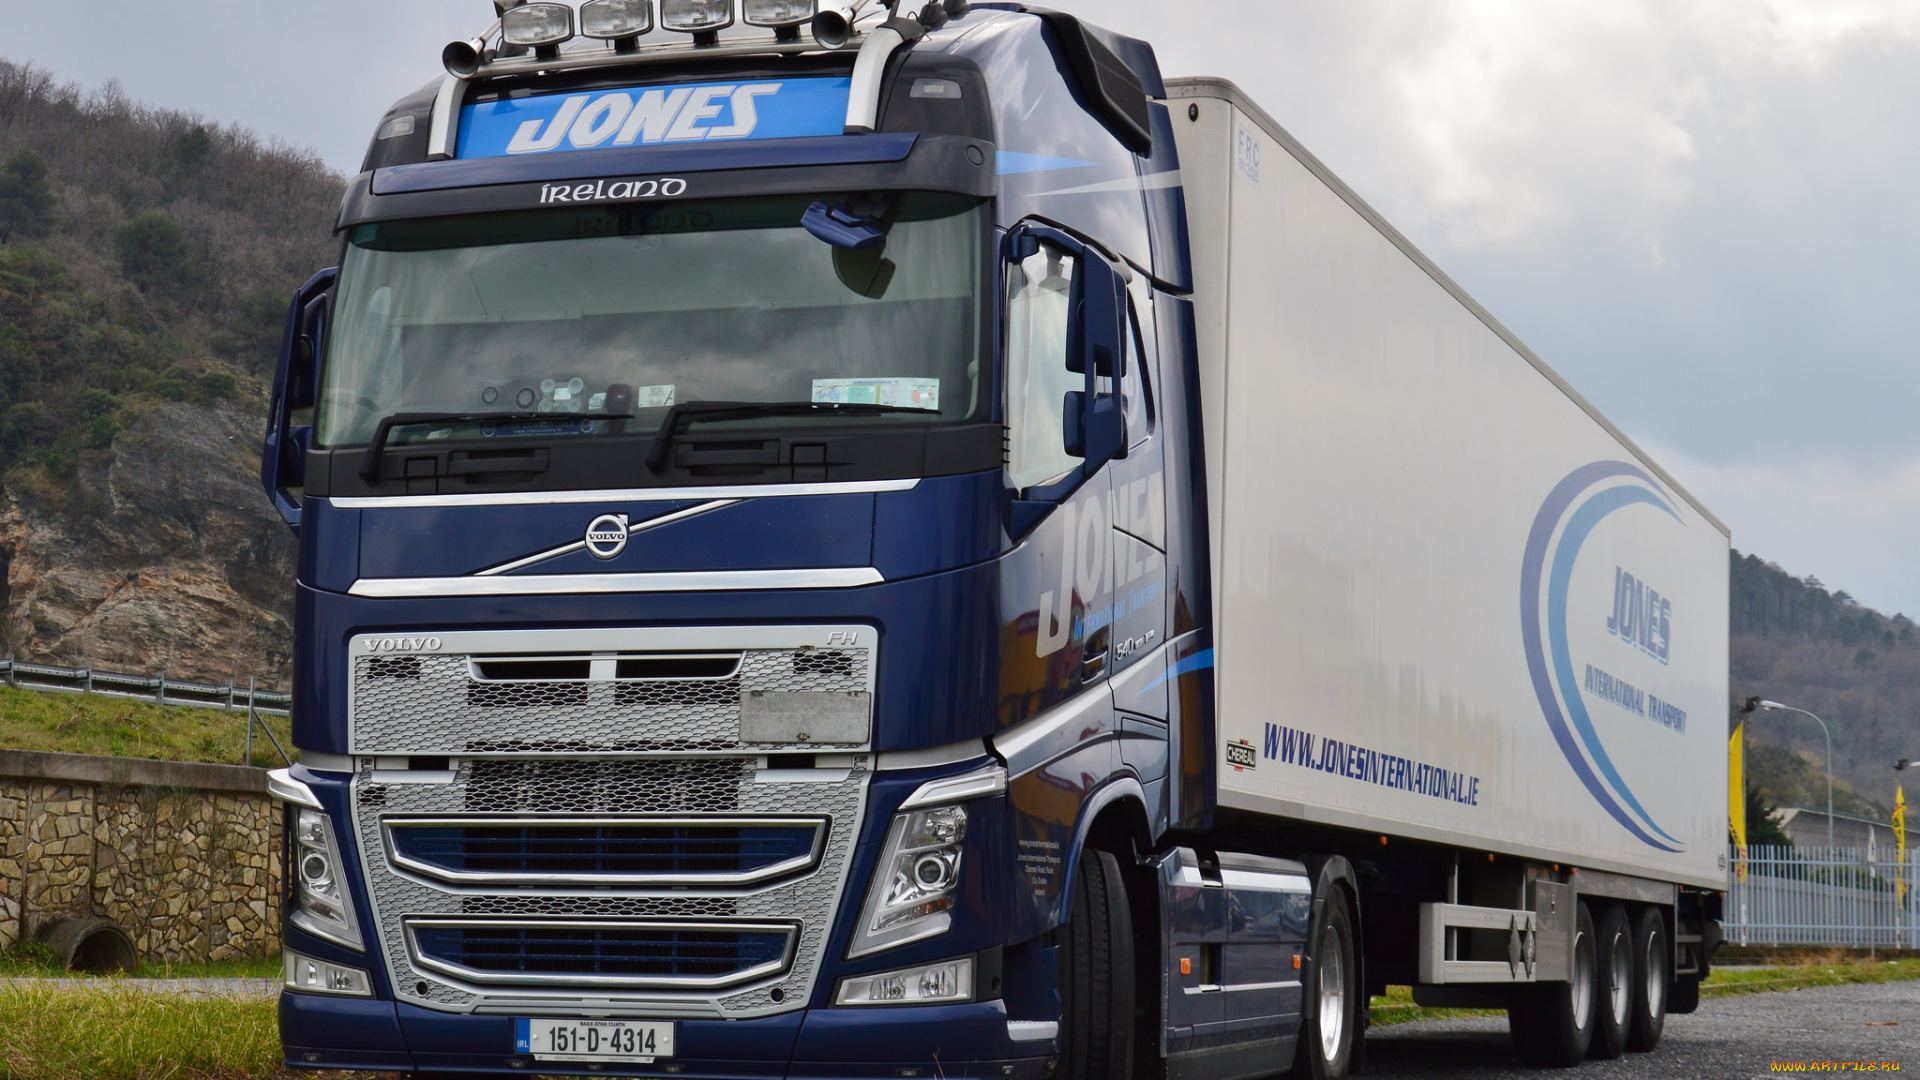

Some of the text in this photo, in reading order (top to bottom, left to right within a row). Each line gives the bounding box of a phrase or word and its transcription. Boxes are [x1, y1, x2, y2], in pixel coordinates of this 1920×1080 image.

[506, 83, 783, 154] JONES
[1036, 471, 1164, 658] JONES
[827, 631, 858, 645] FH
[1607, 566, 1672, 665] JONES
[363, 637, 442, 652] VOLVO
[1116, 637, 1134, 661] 540
[1585, 664, 1687, 735] INTERNATIONAL TRANSPORT
[1264, 722, 1479, 806] WWW.JONESINTERNATIONAL.IE
[517, 1040, 529, 1048] IRL
[549, 1026, 656, 1054] 151-D-4314
